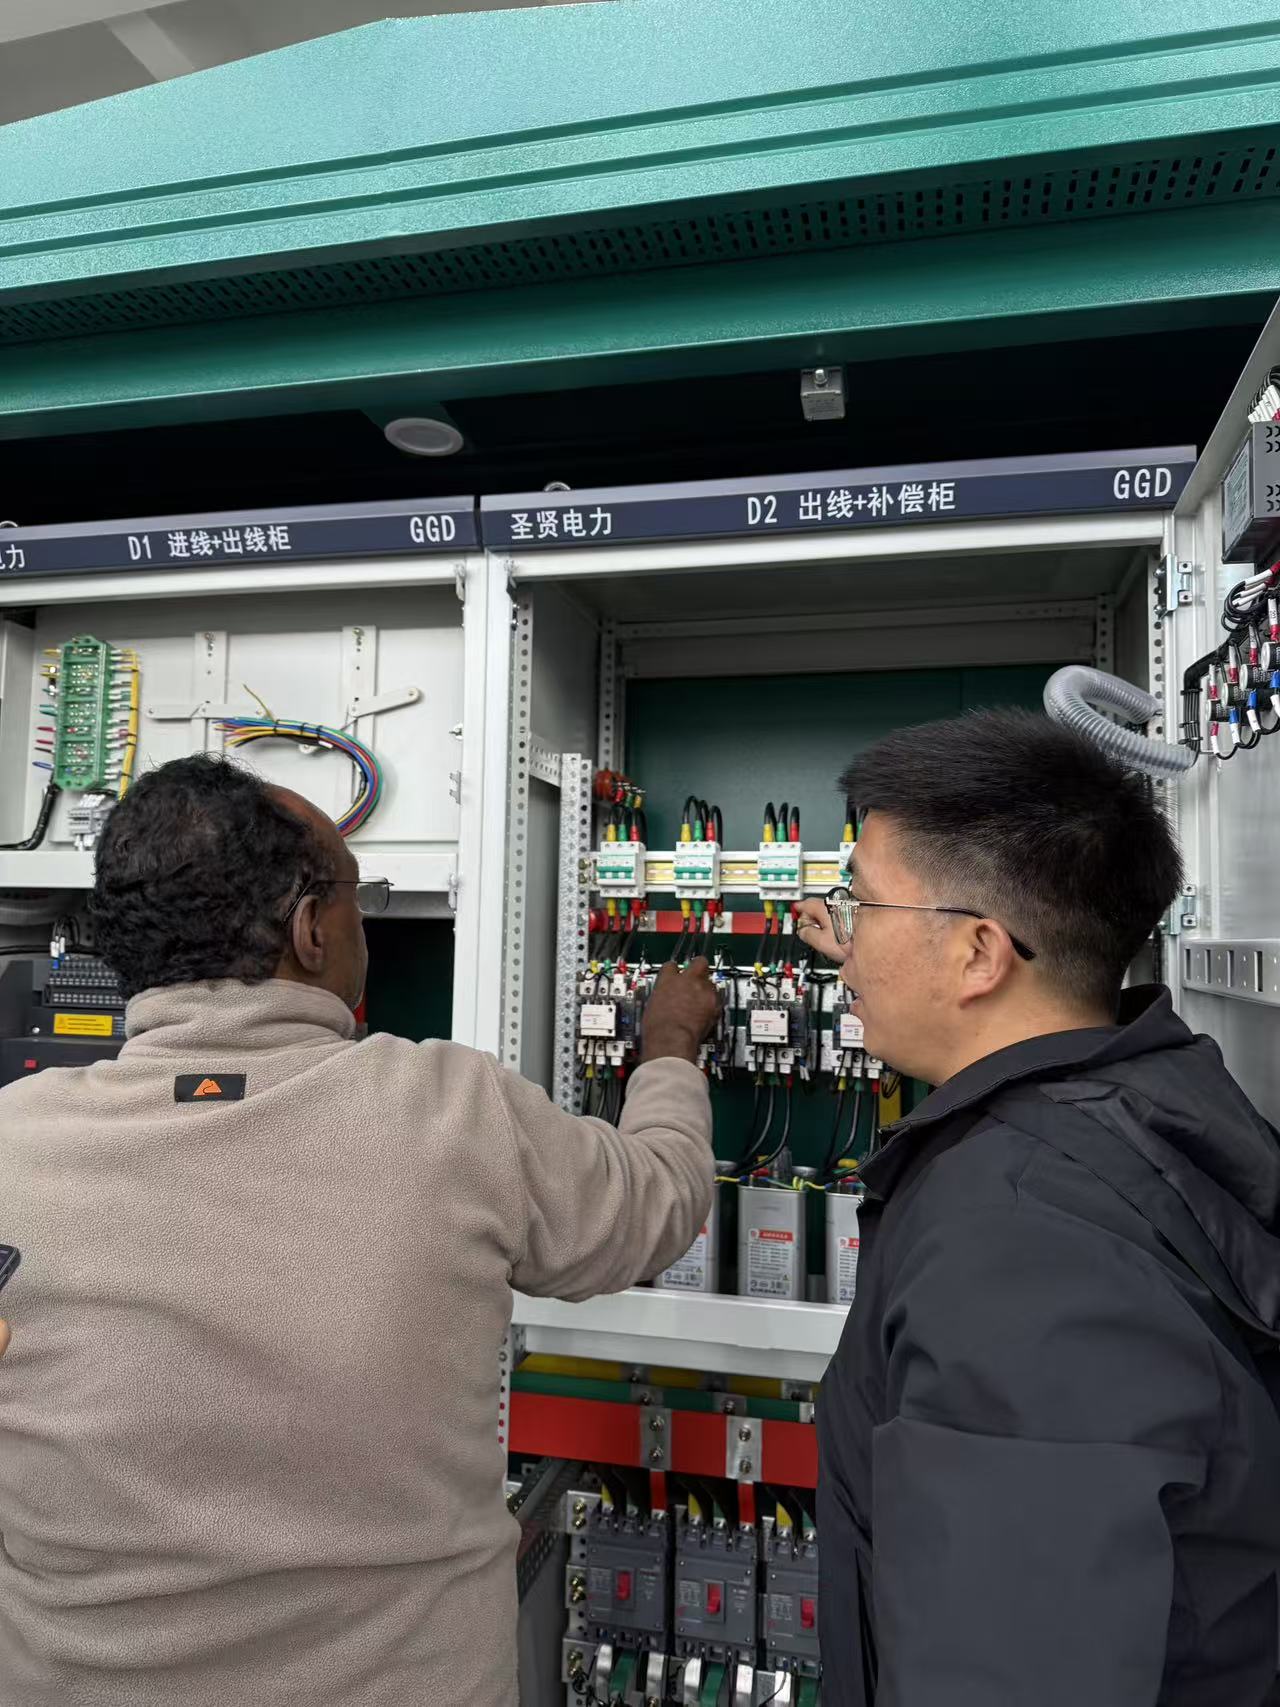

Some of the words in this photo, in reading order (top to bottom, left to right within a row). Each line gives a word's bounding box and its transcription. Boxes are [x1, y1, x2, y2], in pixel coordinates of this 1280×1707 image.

[1113, 467, 1172, 500] GGD
[747, 495, 778, 525] D2
[799, 482, 956, 521] 出线+补偿柜
[410, 514, 456, 543] GGD
[510, 507, 613, 540] 圣贤电力
[128, 536, 152, 561] D1
[168, 525, 291, 558] 进线+出线柜
